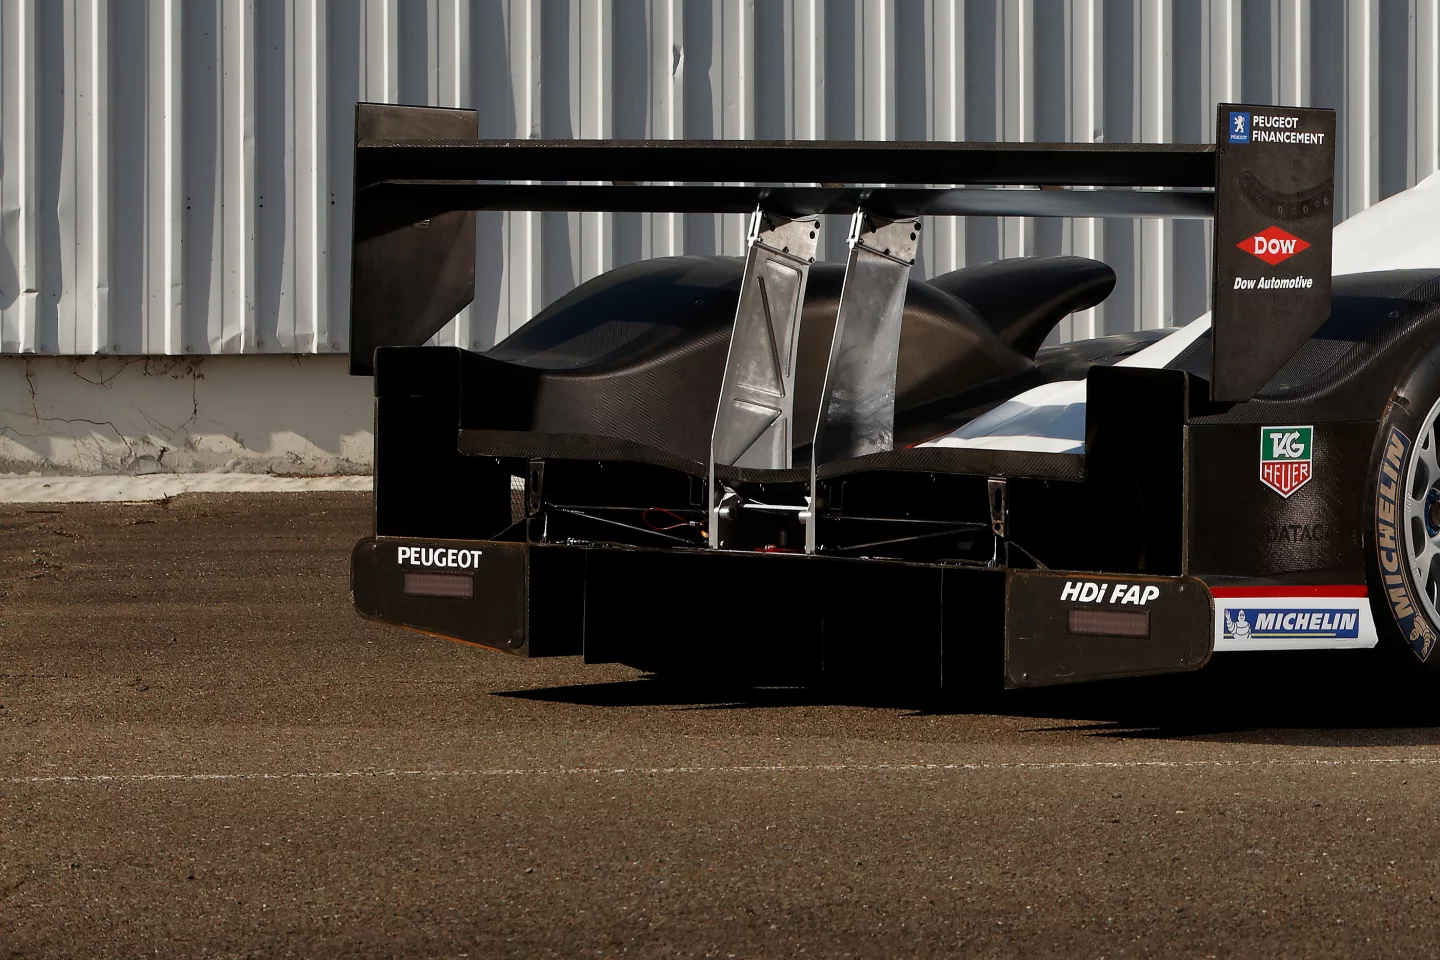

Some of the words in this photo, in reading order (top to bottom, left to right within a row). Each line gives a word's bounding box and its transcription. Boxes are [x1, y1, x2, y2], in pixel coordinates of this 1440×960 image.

[1252, 115, 1299, 129] PEUGEOT
[1252, 130, 1325, 145] FINANCEMENT
[1233, 276, 1257, 290] Dow
[1257, 275, 1313, 290] Automotive
[1269, 431, 1305, 459] TAG
[1264, 464, 1309, 492] HEUER
[1378, 434, 1415, 620] MICHELIN
[397, 546, 483, 569] PEUGEOT
[1060, 581, 1106, 604] HDi
[1108, 583, 1160, 606] FAP
[1254, 612, 1358, 631] MICHELIN
